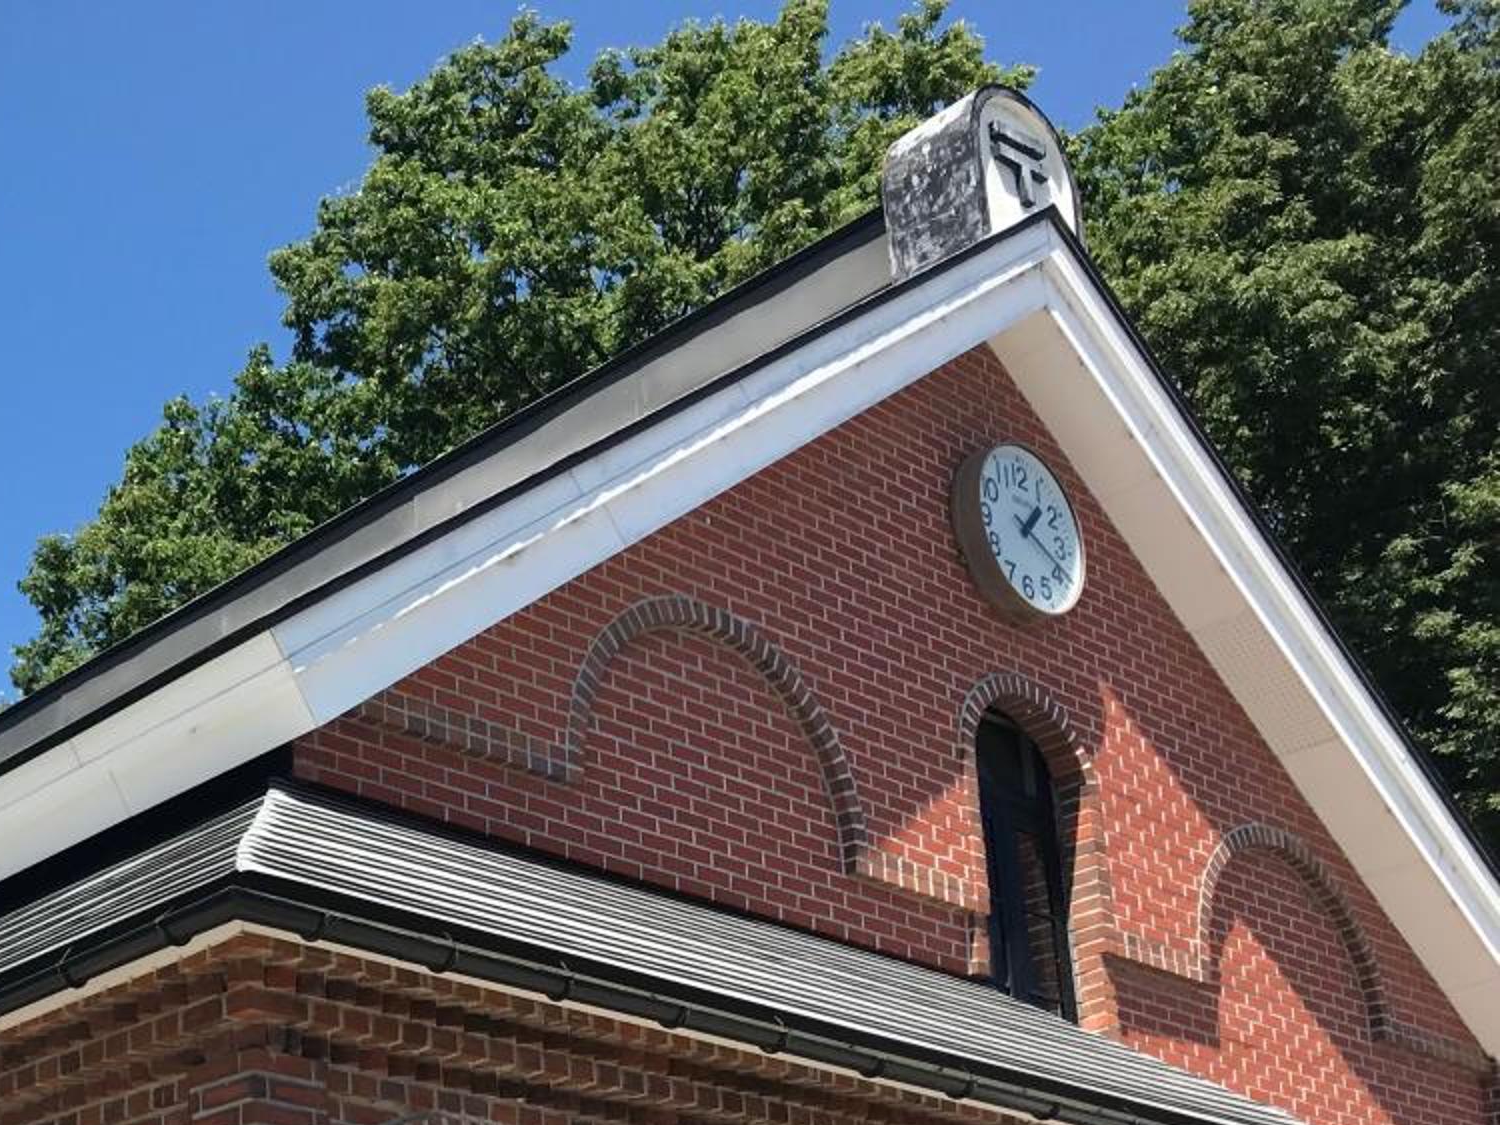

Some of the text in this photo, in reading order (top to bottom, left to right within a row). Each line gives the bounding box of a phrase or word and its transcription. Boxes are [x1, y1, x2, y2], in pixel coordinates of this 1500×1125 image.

[1012, 463, 1029, 491] 12
[981, 503, 992, 526] 9
[1046, 505, 1058, 530] 2
[990, 532, 1001, 557] 8
[1053, 536, 1066, 560] 3
[1004, 560, 1016, 581] 7
[1051, 566, 1064, 584] 4
[1021, 575, 1035, 600] 6
[1040, 577, 1053, 601] 5
